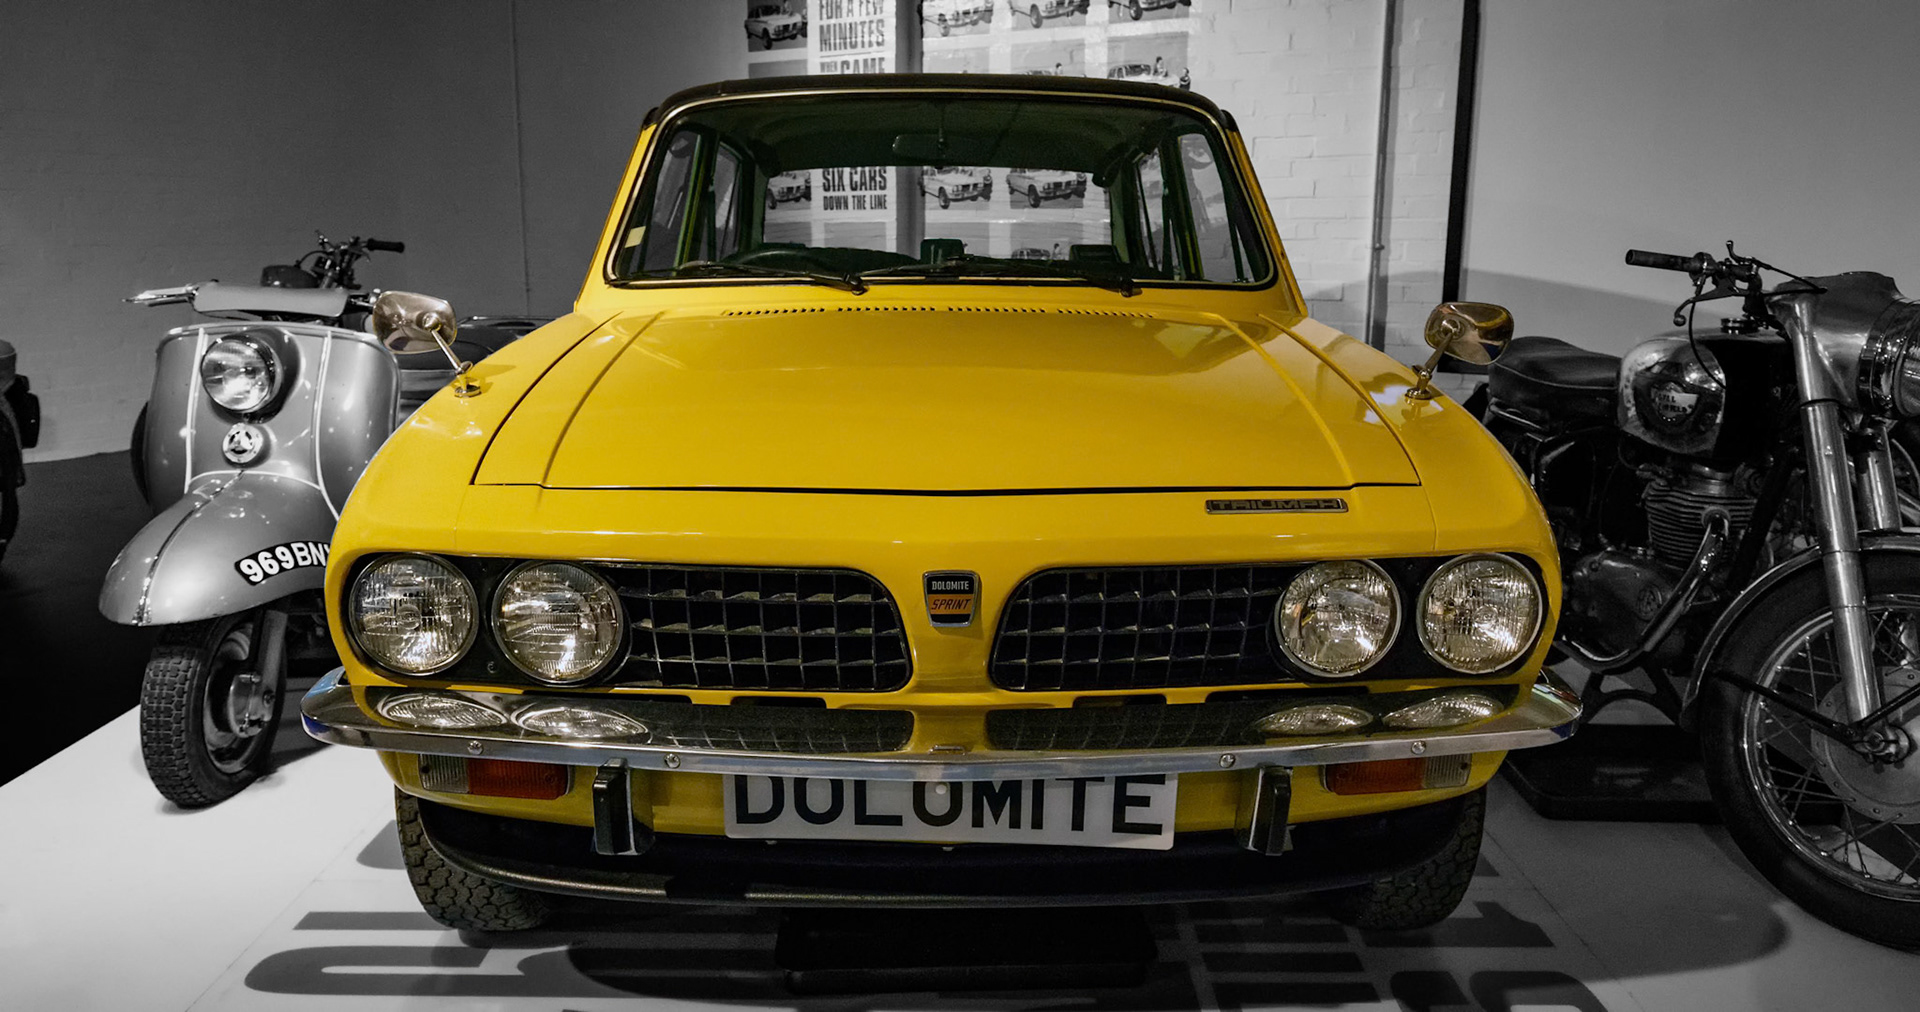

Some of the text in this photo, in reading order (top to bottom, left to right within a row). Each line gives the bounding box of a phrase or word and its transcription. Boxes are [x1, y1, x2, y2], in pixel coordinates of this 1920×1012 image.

[820, 0, 842, 20] FOR
[847, 0, 854, 17] A
[819, 19, 885, 52] MINUTES
[841, 57, 885, 74] CAME
[822, 166, 887, 192] SIX CARS
[823, 194, 887, 211] DOWN THE LINE
[1212, 500, 1339, 511] TRIUMPH
[931, 580, 970, 591] DOLOMITE
[931, 598, 971, 610] SPRINT
[735, 774, 1167, 835] DOLOMITE
